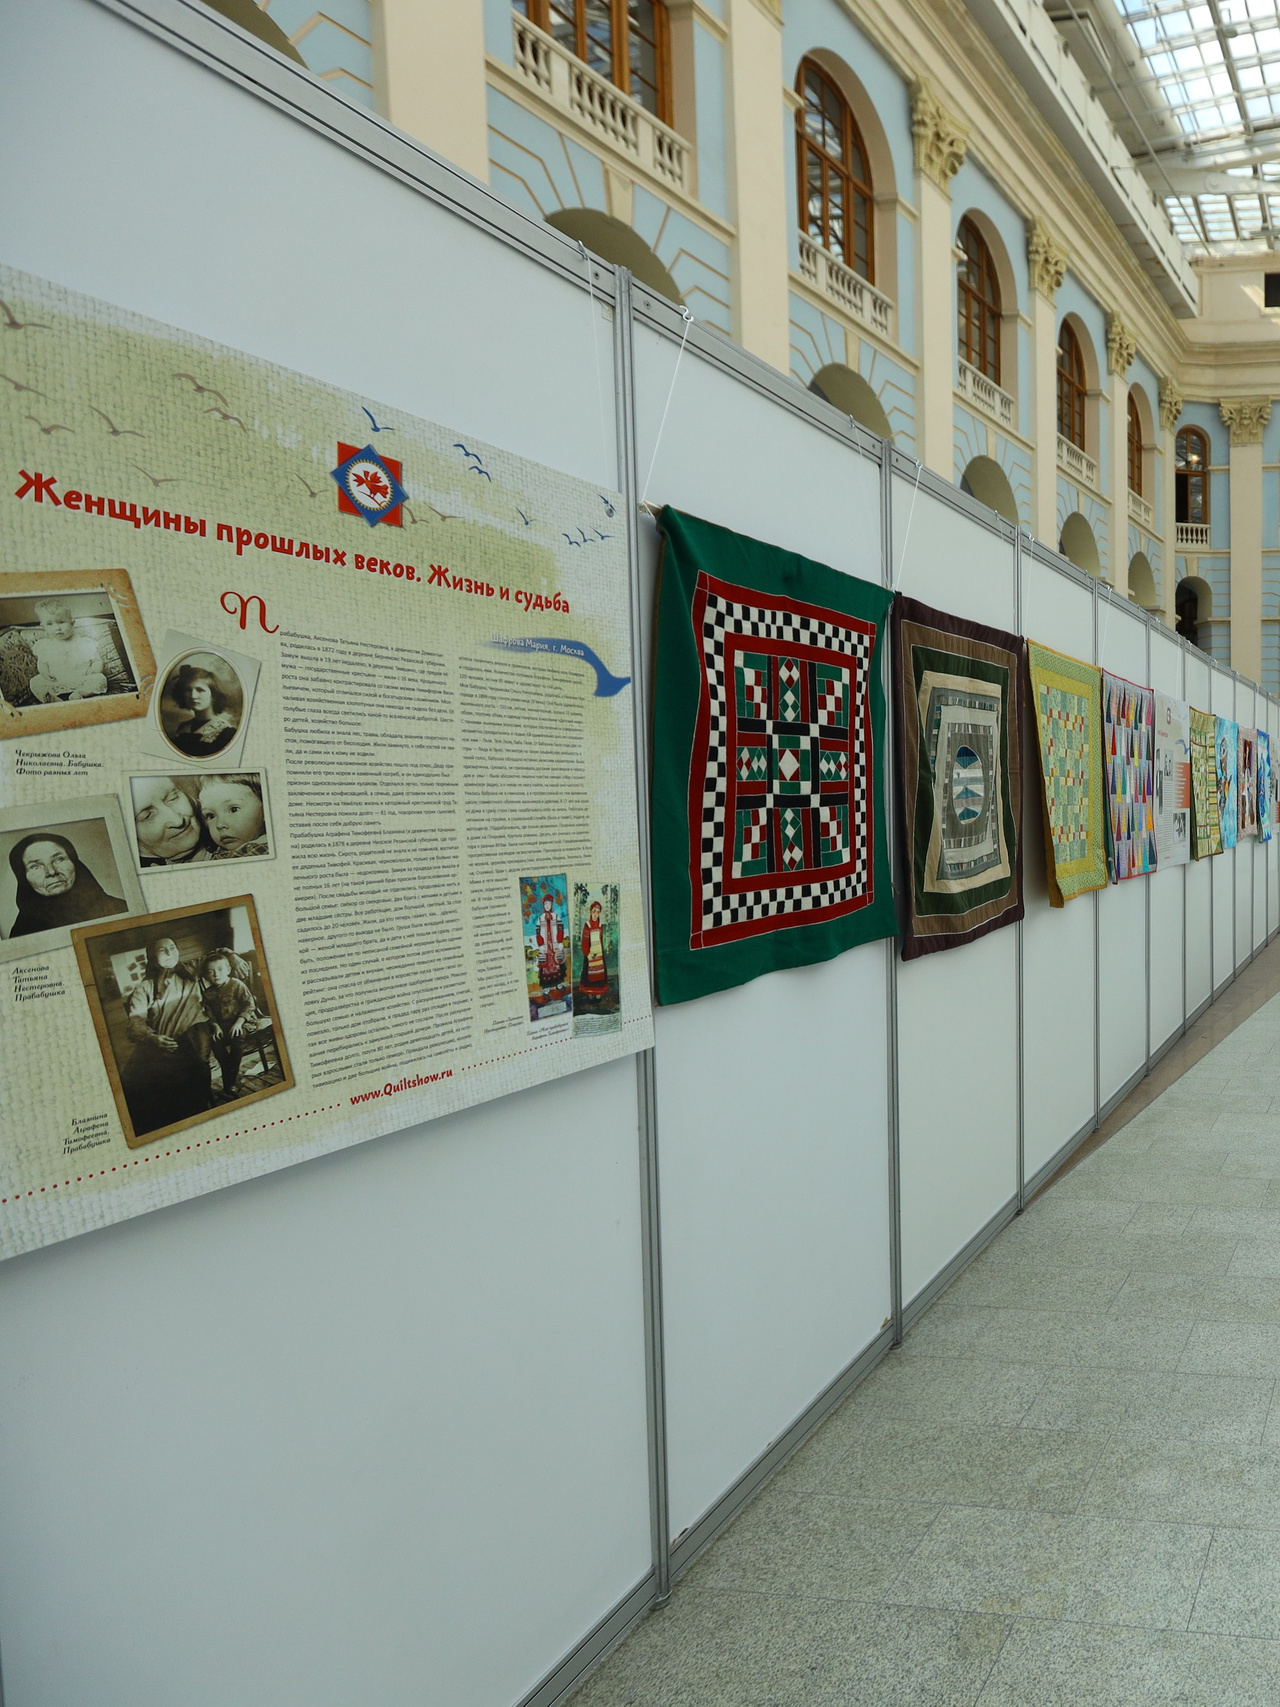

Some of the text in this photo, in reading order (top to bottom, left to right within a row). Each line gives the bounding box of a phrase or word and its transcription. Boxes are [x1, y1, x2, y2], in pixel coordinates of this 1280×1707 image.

[15, 470, 569, 612] Женщины прошлых веков. Жизнь и судьба
[491, 633, 524, 650] Шафрова
[526, 636, 550, 652] Мария,
[560, 645, 585, 656] Москва
[15, 750, 60, 758] Чекрыжова
[12, 966, 50, 975] Аксенова
[13, 974, 48, 984] Татьяна
[14, 981, 65, 992] Нестеровна.
[15, 990, 66, 1001] Прабабушка
[350, 1069, 453, 1105] www.Quiltshow.ru
[73, 1121, 109, 1135] Аграфена
[63, 1138, 111, 1154] Прабабушка
